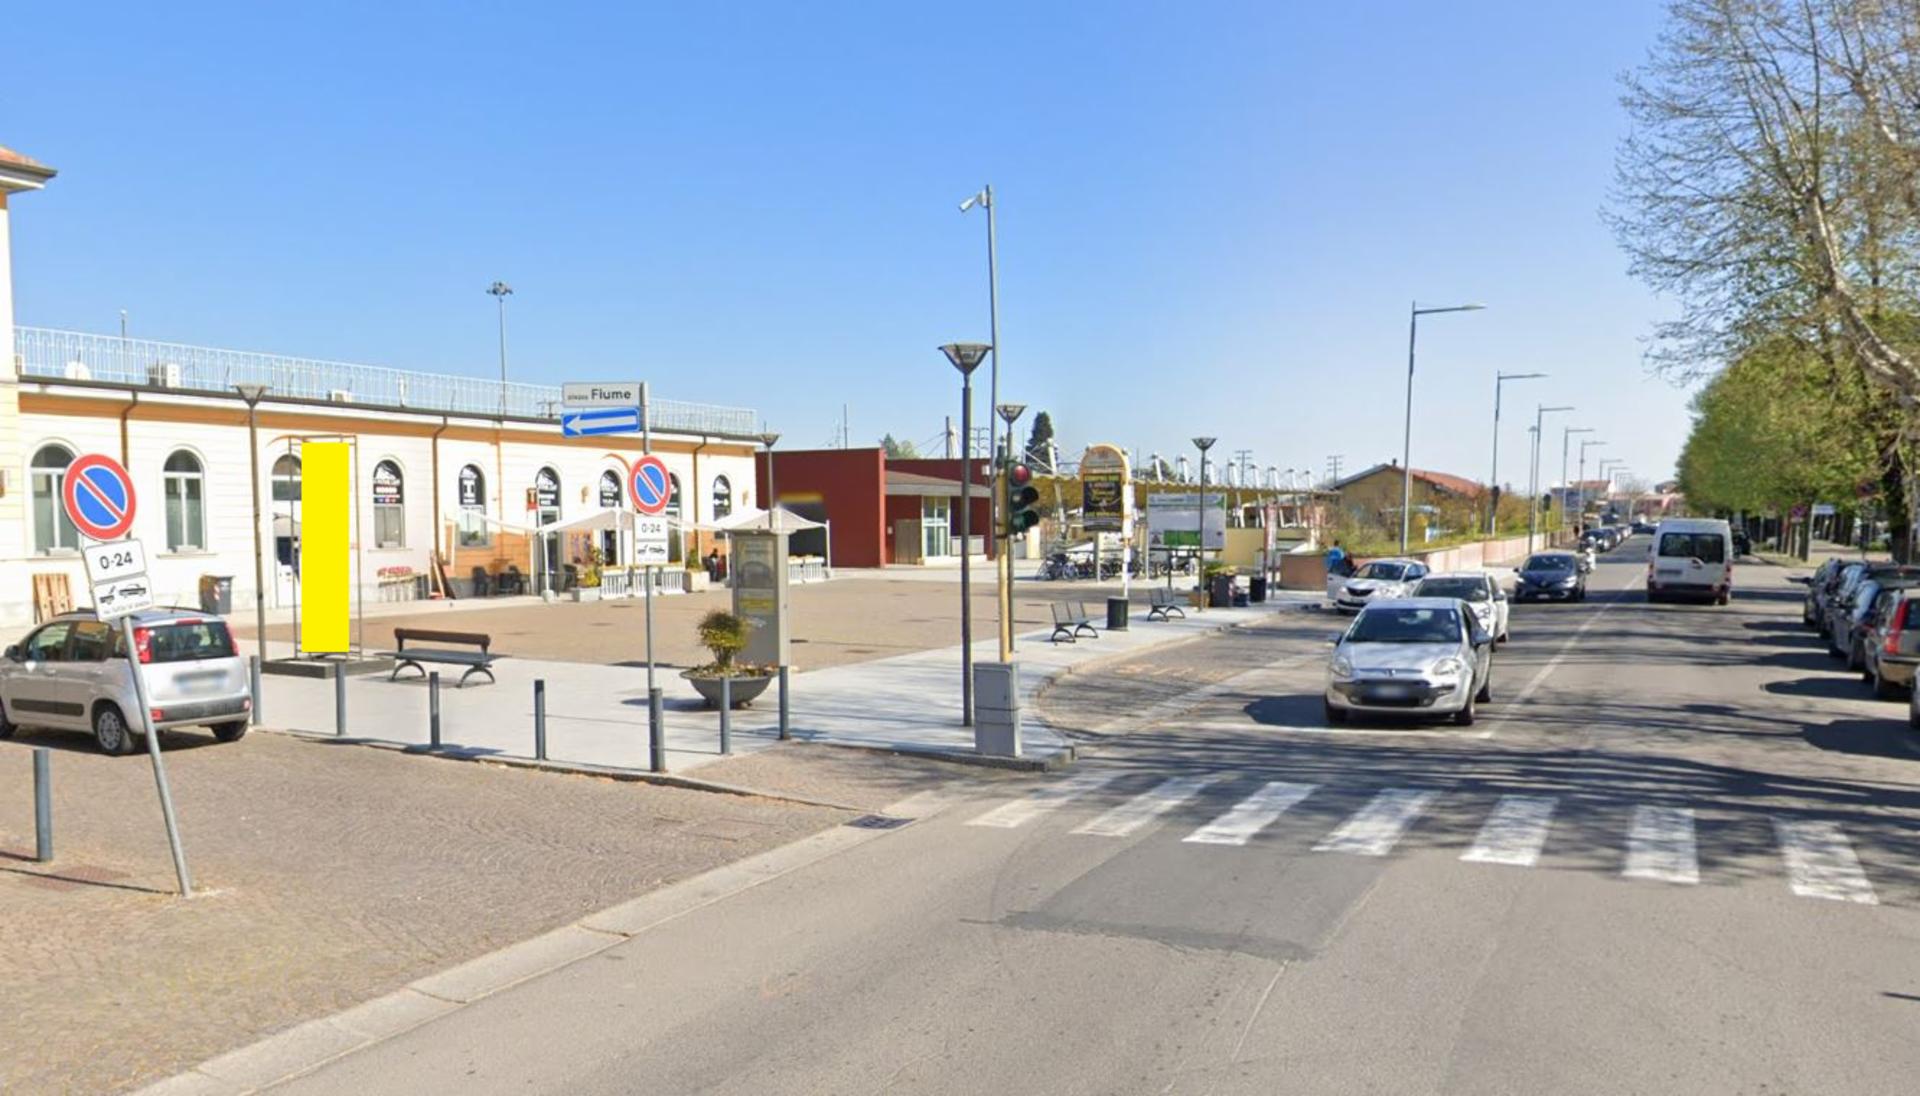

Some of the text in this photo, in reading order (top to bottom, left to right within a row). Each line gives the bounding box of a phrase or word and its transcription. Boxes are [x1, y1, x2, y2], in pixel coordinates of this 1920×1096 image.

[591, 388, 631, 400] Fiume
[641, 523, 661, 533] 0-24
[99, 551, 133, 569] 0-24
